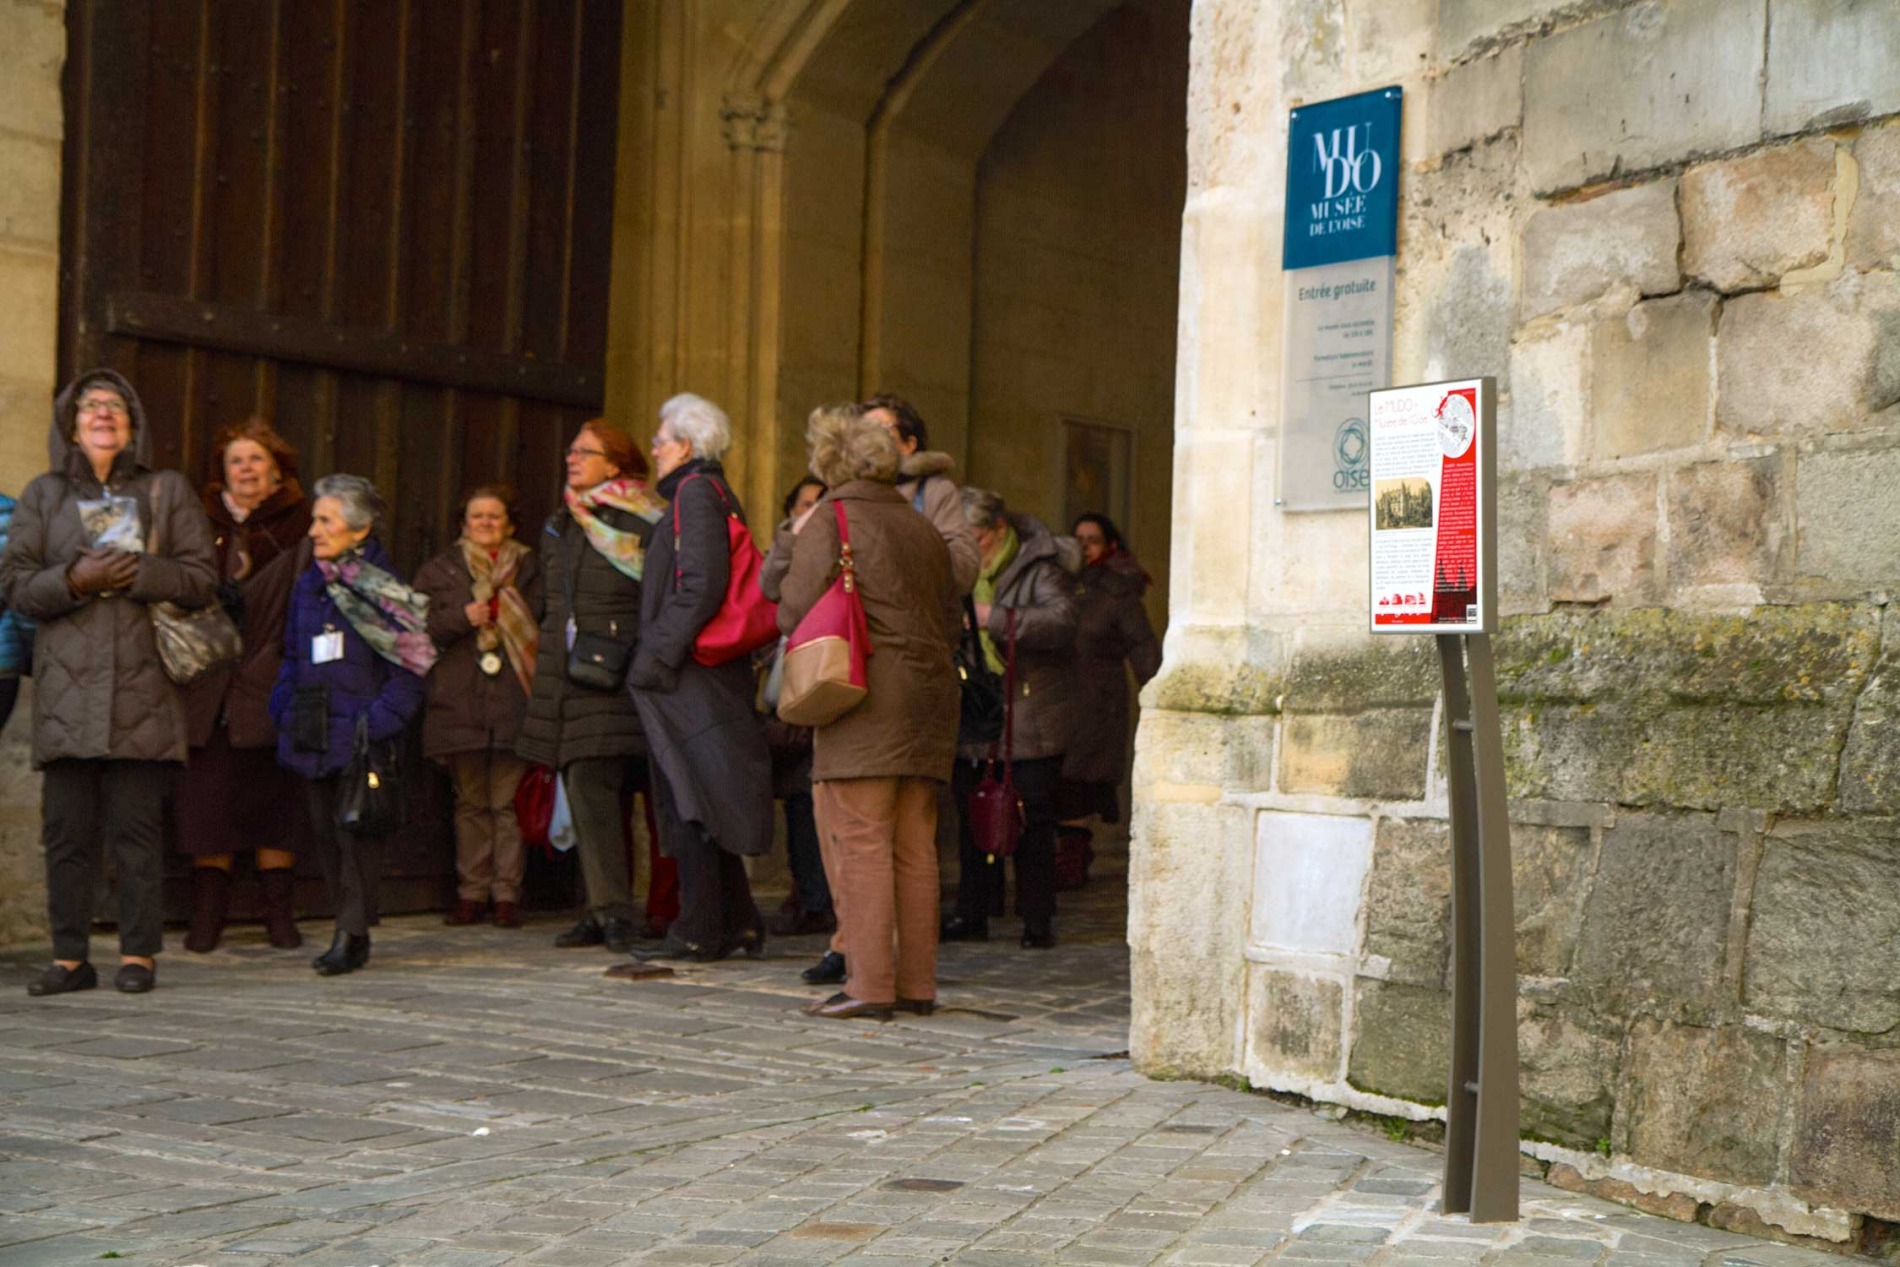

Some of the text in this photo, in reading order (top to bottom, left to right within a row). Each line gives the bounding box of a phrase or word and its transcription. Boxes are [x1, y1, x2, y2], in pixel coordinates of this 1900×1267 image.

[1309, 221, 1326, 237] DE
[1298, 278, 1376, 301] Entrée gratuite
